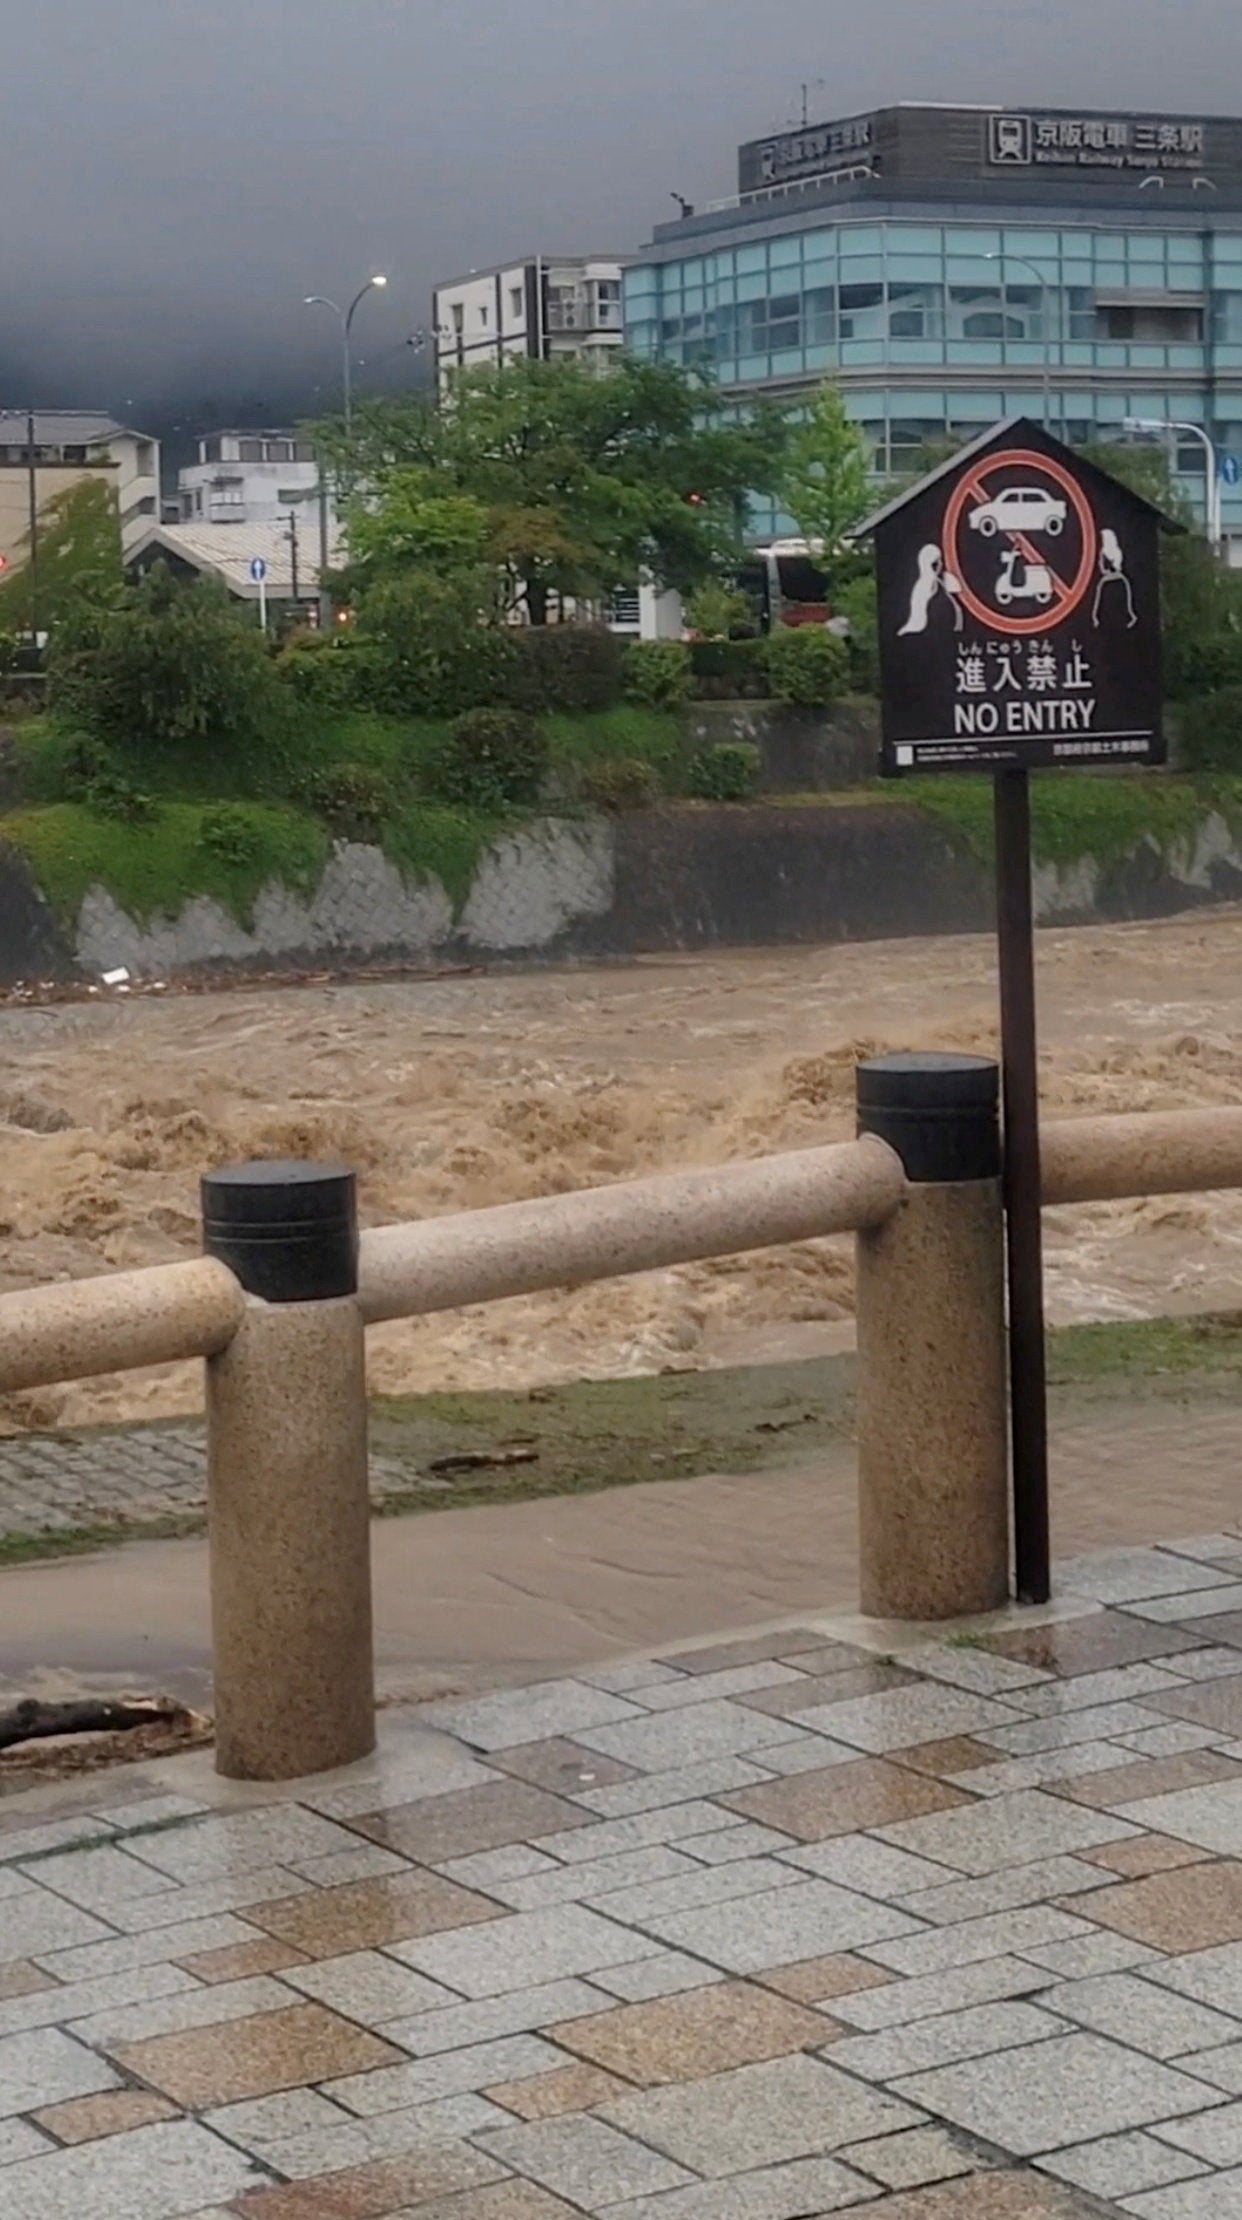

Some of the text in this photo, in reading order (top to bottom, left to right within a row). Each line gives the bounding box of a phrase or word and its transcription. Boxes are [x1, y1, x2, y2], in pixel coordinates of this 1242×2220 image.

[1036, 121, 1202, 152] 京阪電車 三条駅
[956, 654, 1093, 692] 進入禁止
[954, 699, 1095, 733] NO ENTRY
